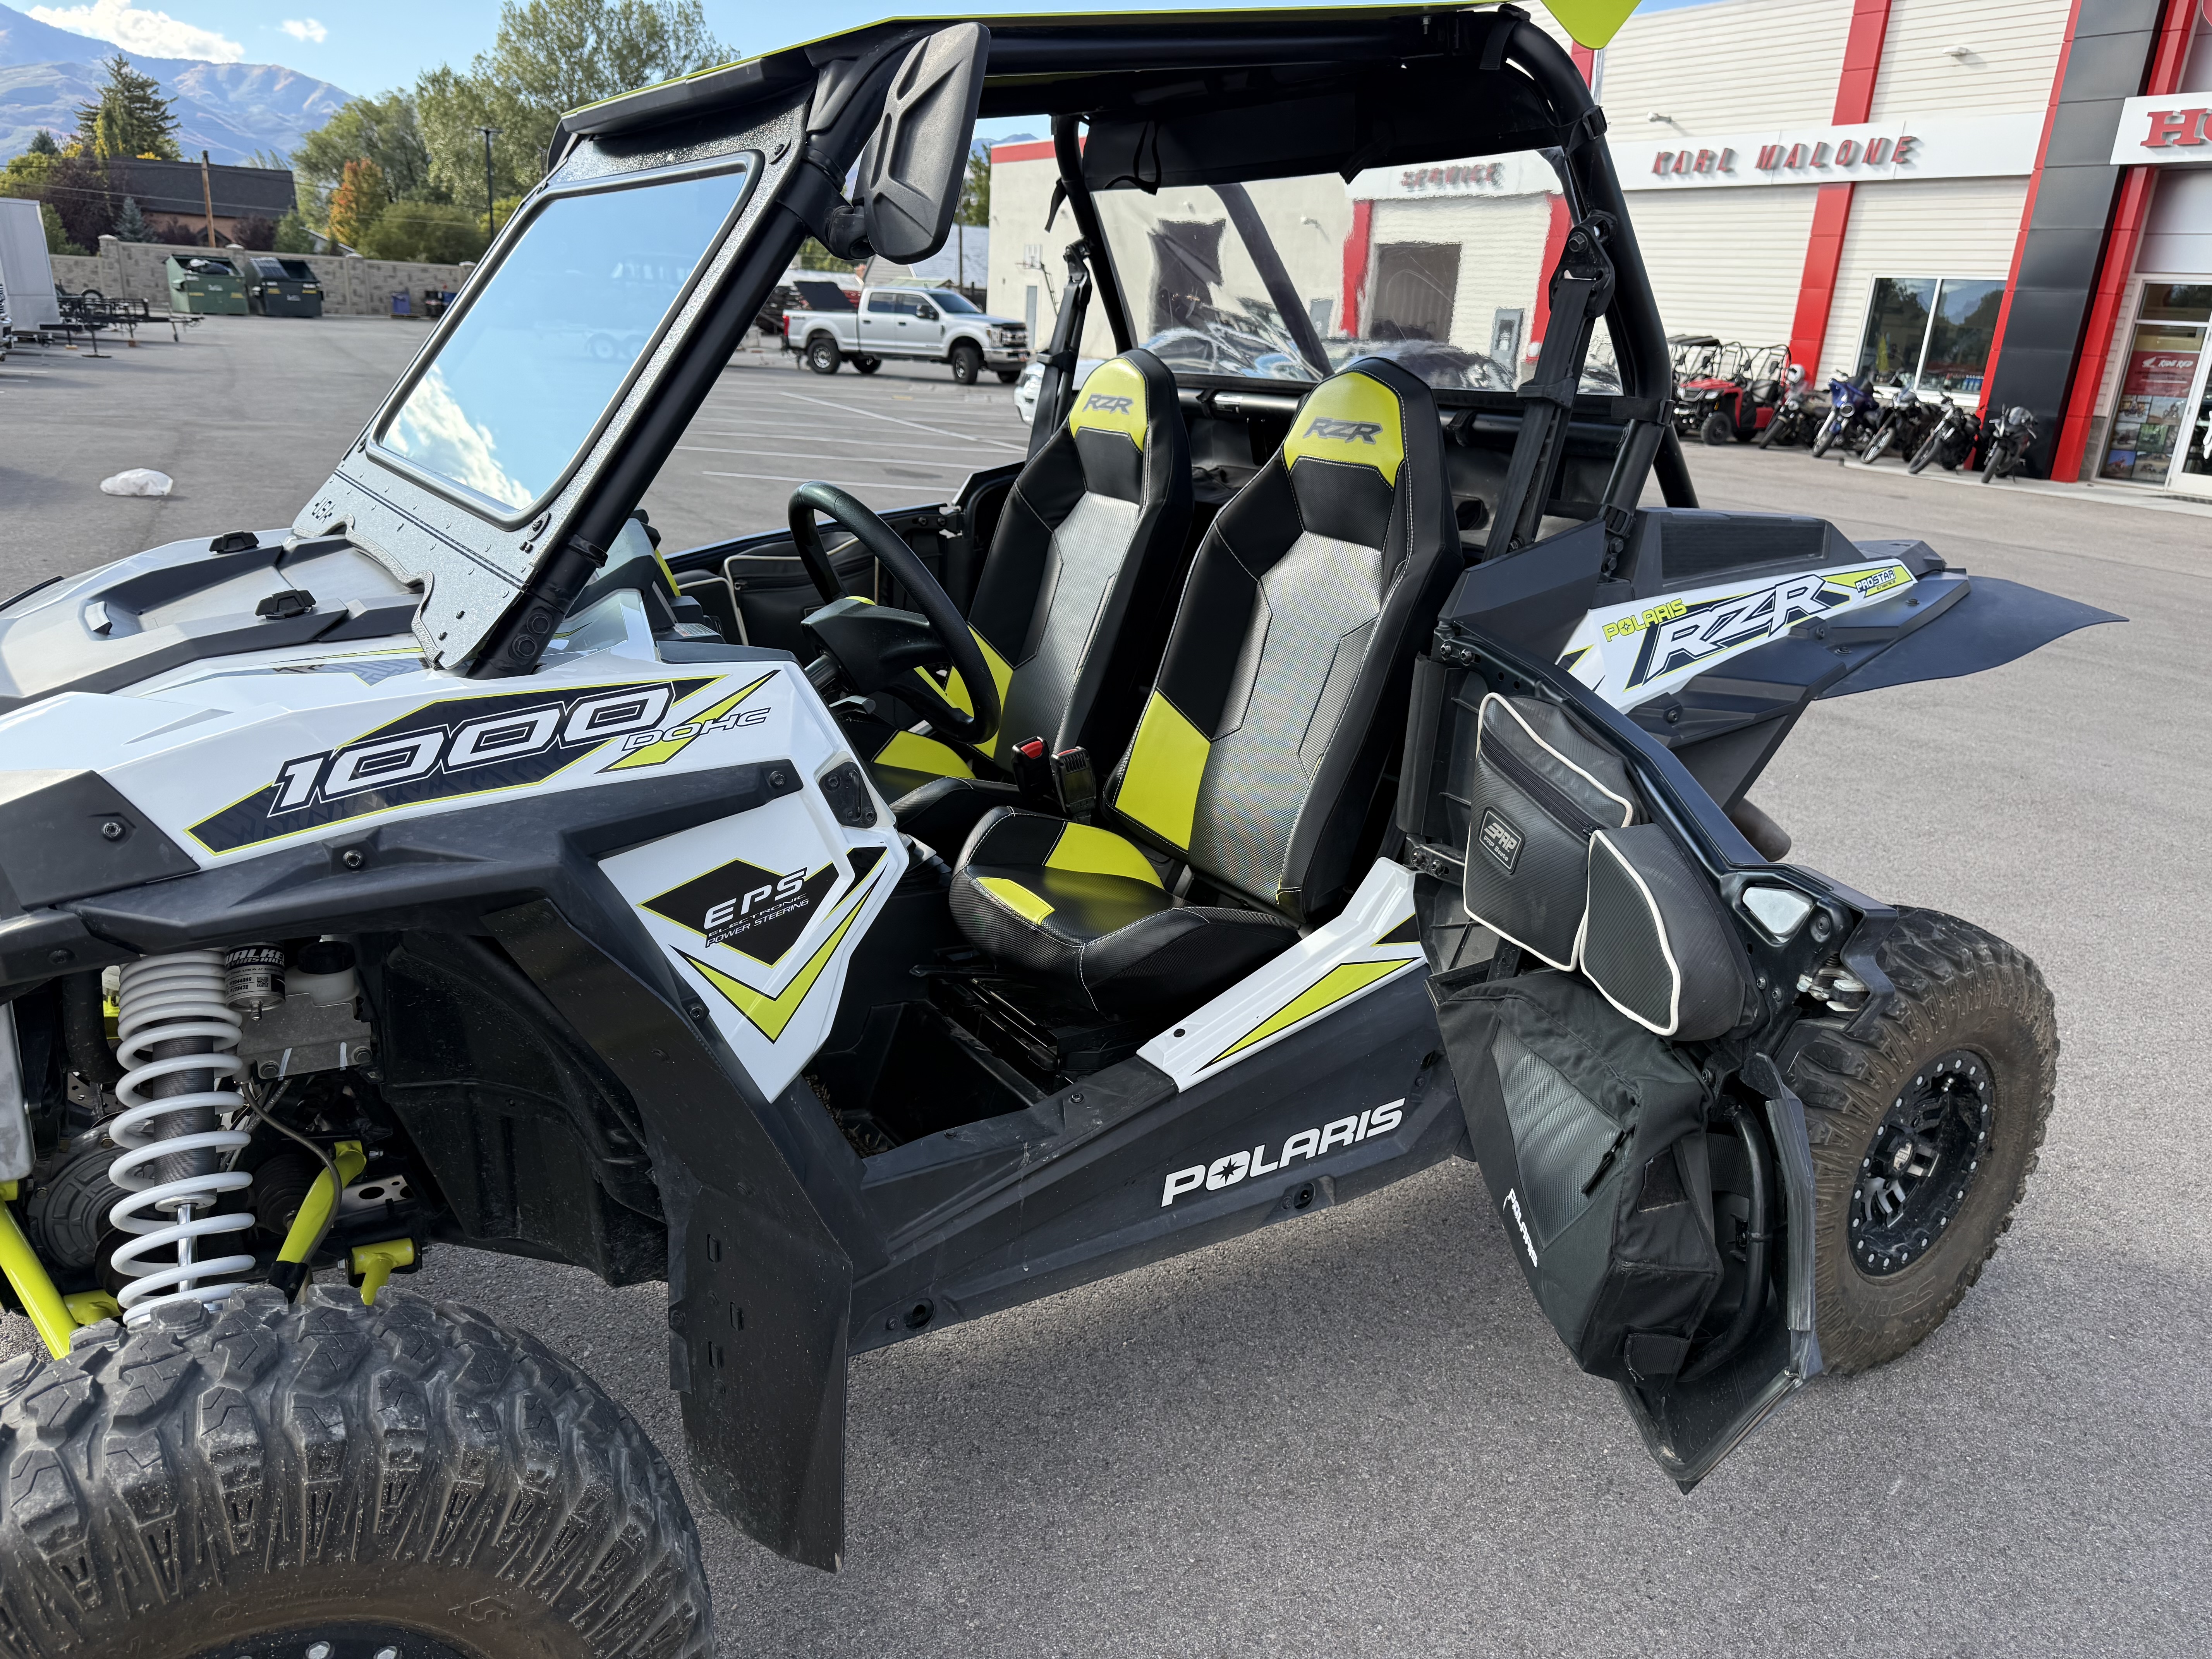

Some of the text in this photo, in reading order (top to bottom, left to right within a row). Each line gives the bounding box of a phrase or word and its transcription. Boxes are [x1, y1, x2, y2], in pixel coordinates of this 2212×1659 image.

[1652, 136, 1913, 174] KARL MALONE
[1082, 393, 1133, 415] RZR
[1302, 416, 1383, 445] RZR
[1855, 569, 1895, 592] PROSTAR
[1602, 598, 1687, 642] POLARIS
[1642, 574, 1831, 686] RZR
[268, 681, 675, 817] 1000
[621, 707, 771, 752] DOHC
[1484, 822, 1517, 851] PRP
[1484, 835, 1495, 847] PRP
[704, 870, 805, 929] EPS
[708, 893, 807, 937] ELECTRONIC
[706, 898, 809, 947] POWER STEERING
[1162, 1097, 1405, 1207] POLARIS
[1503, 1188, 1537, 1267] POLARIS
